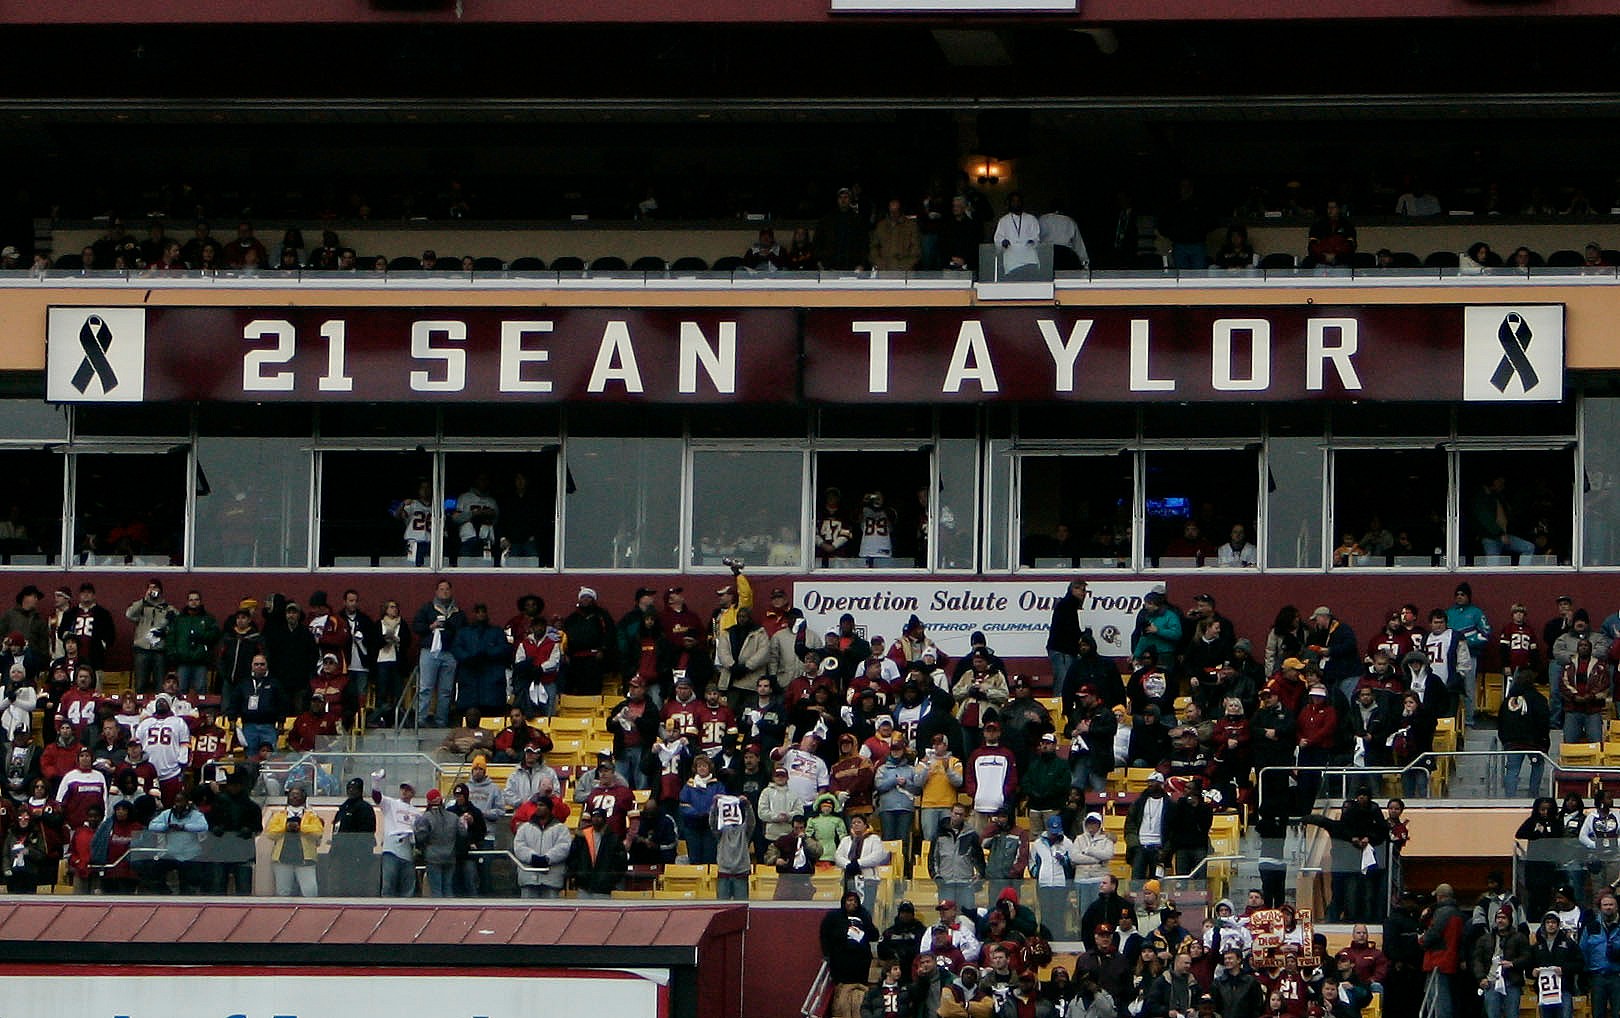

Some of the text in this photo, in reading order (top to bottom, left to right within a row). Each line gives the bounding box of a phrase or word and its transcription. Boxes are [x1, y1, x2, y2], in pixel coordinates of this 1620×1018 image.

[242, 317, 1363, 394] 21 SEAN TAYLOR
[803, 590, 919, 615] Operation
[930, 590, 1008, 611] Salute
[1080, 590, 1147, 615] Troop
[1511, 633, 1531, 650] 26
[67, 700, 96, 725] 44
[147, 726, 172, 746] 56
[196, 735, 218, 753] 26
[722, 802, 740, 818] 21
[1280, 979, 1299, 1000] 21
[1540, 973, 1560, 992] 21
